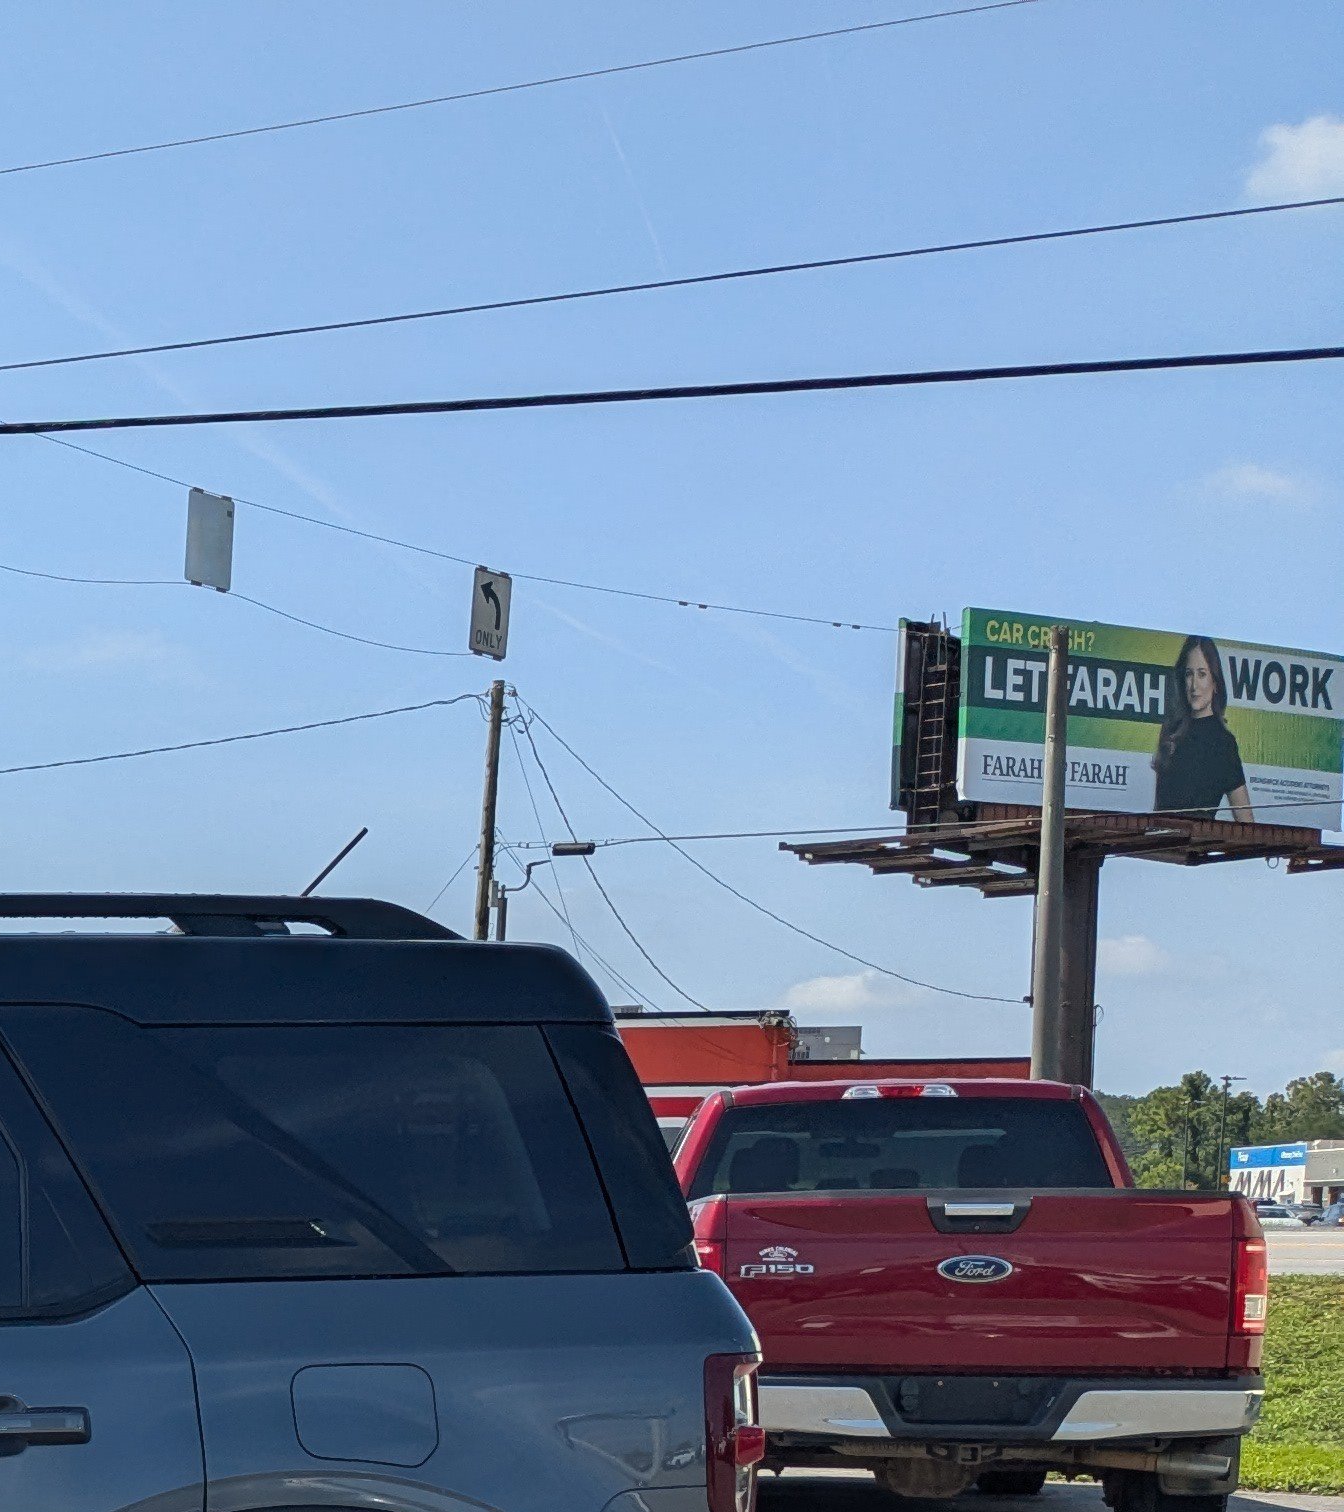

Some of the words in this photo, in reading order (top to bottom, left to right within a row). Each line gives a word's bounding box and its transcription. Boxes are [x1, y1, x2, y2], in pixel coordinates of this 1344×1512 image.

[475, 629, 503, 650] ONLY
[986, 620, 1024, 645] CAR
[1027, 625, 1096, 652] CRH?
[984, 655, 1047, 703] LET
[1067, 664, 1166, 715] ARAH
[1228, 655, 1334, 710] WORK
[982, 754, 1043, 780] FARAH
[1070, 761, 1130, 786] FARAH
[954, 1260, 996, 1276] Ford
